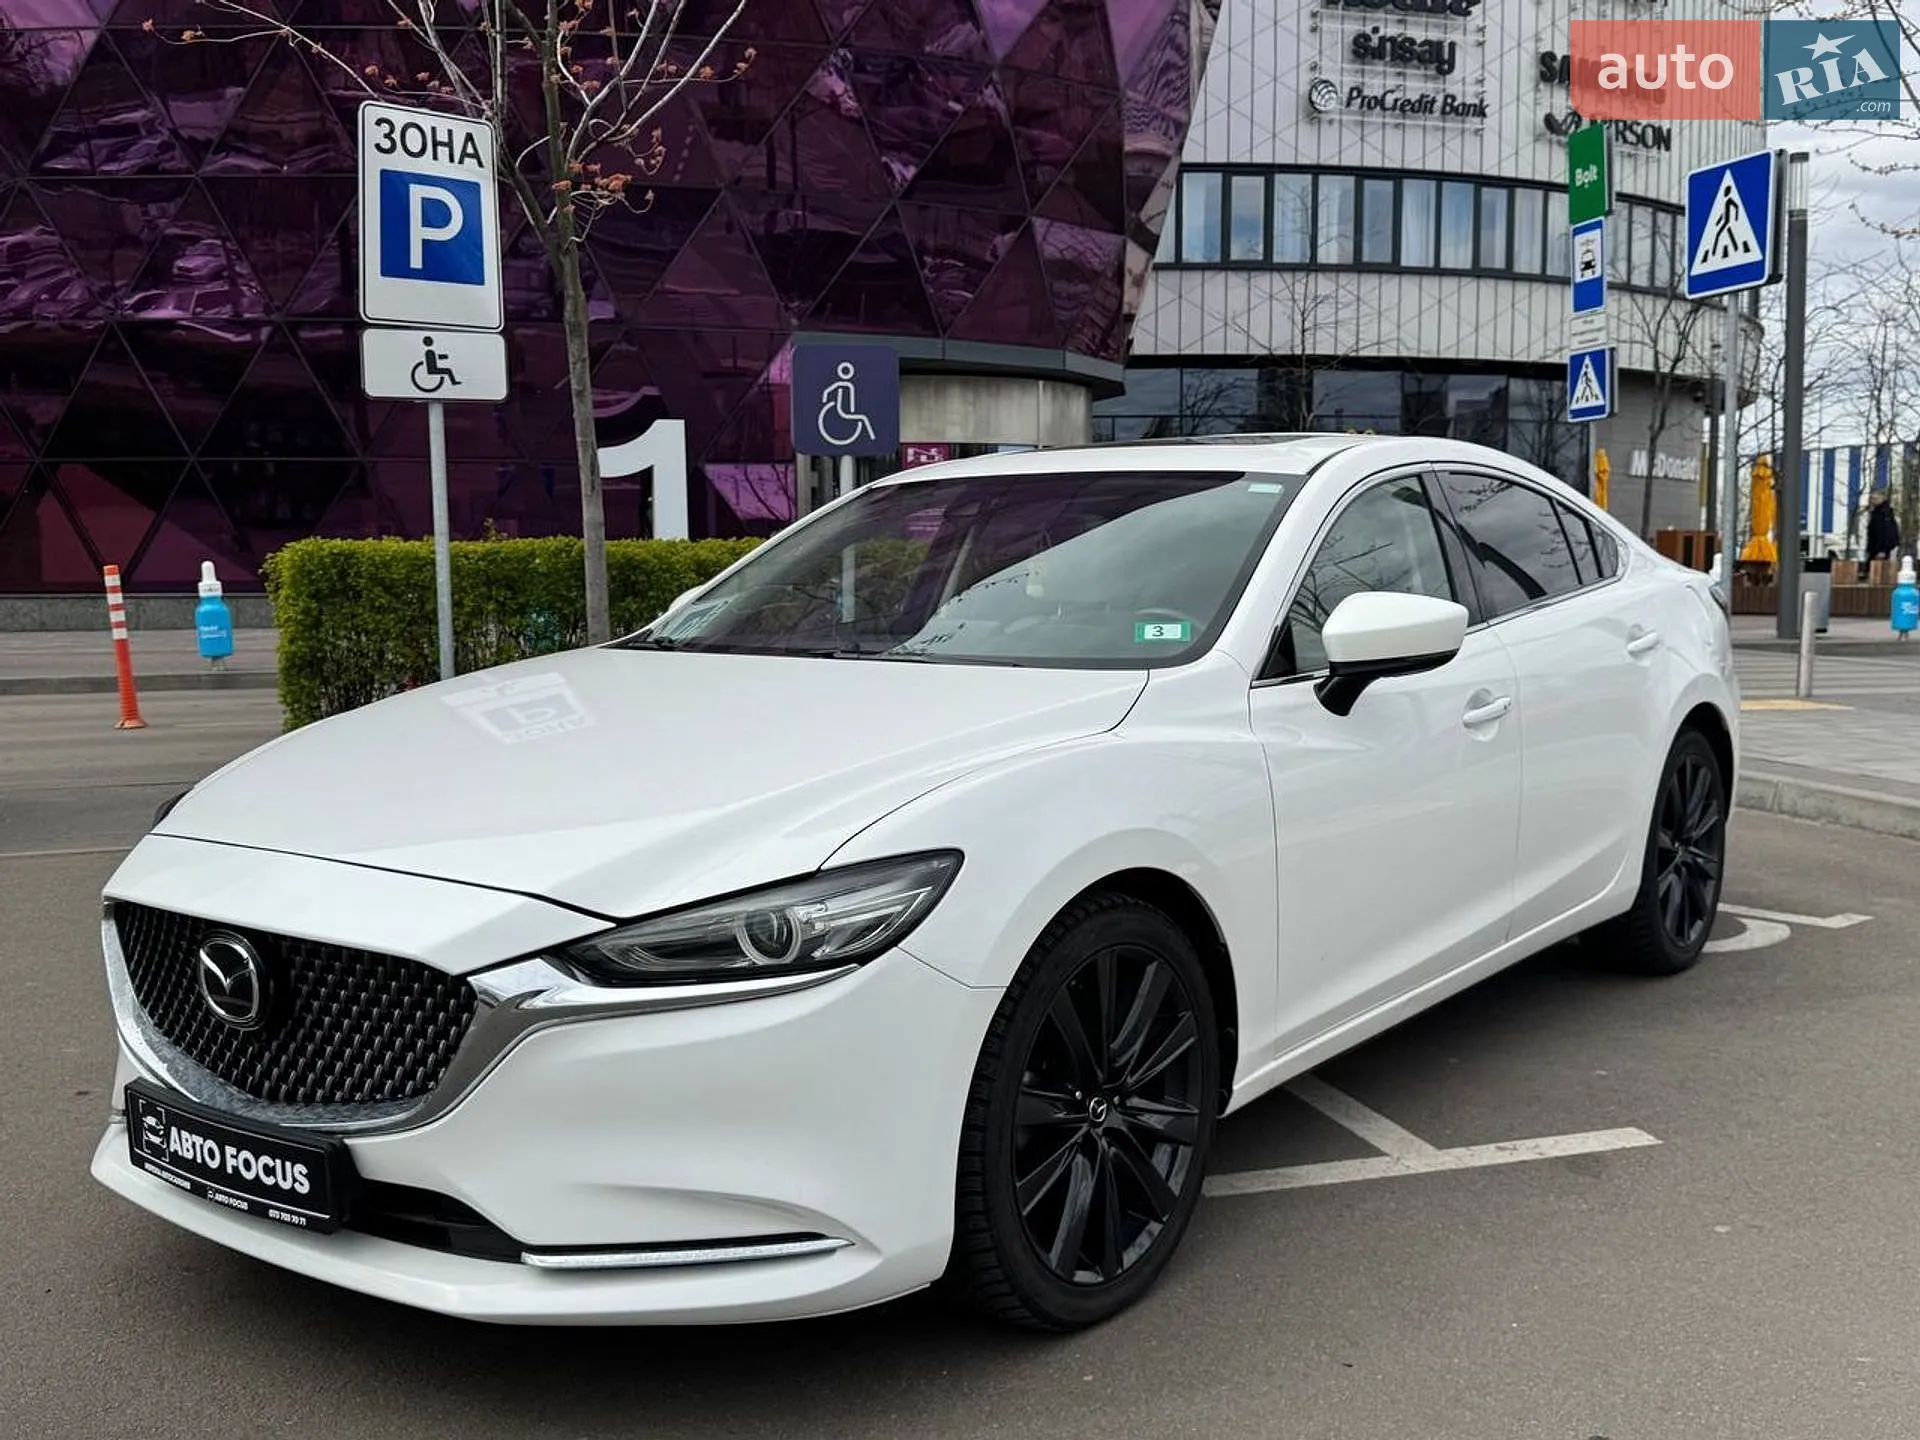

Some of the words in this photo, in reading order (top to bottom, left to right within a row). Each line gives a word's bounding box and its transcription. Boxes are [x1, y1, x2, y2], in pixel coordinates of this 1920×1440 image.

[1352, 26, 1457, 76] sinsay
[1346, 87, 1436, 114] ProCredit
[1440, 94, 1489, 118] Bank
[374, 117, 485, 168] ЗОНА
[1575, 164, 1598, 188] Bolt
[409, 184, 463, 270] P
[597, 419, 689, 540] 1
[1152, 625, 1165, 637] 3
[225, 1145, 310, 1194] FOCUS
